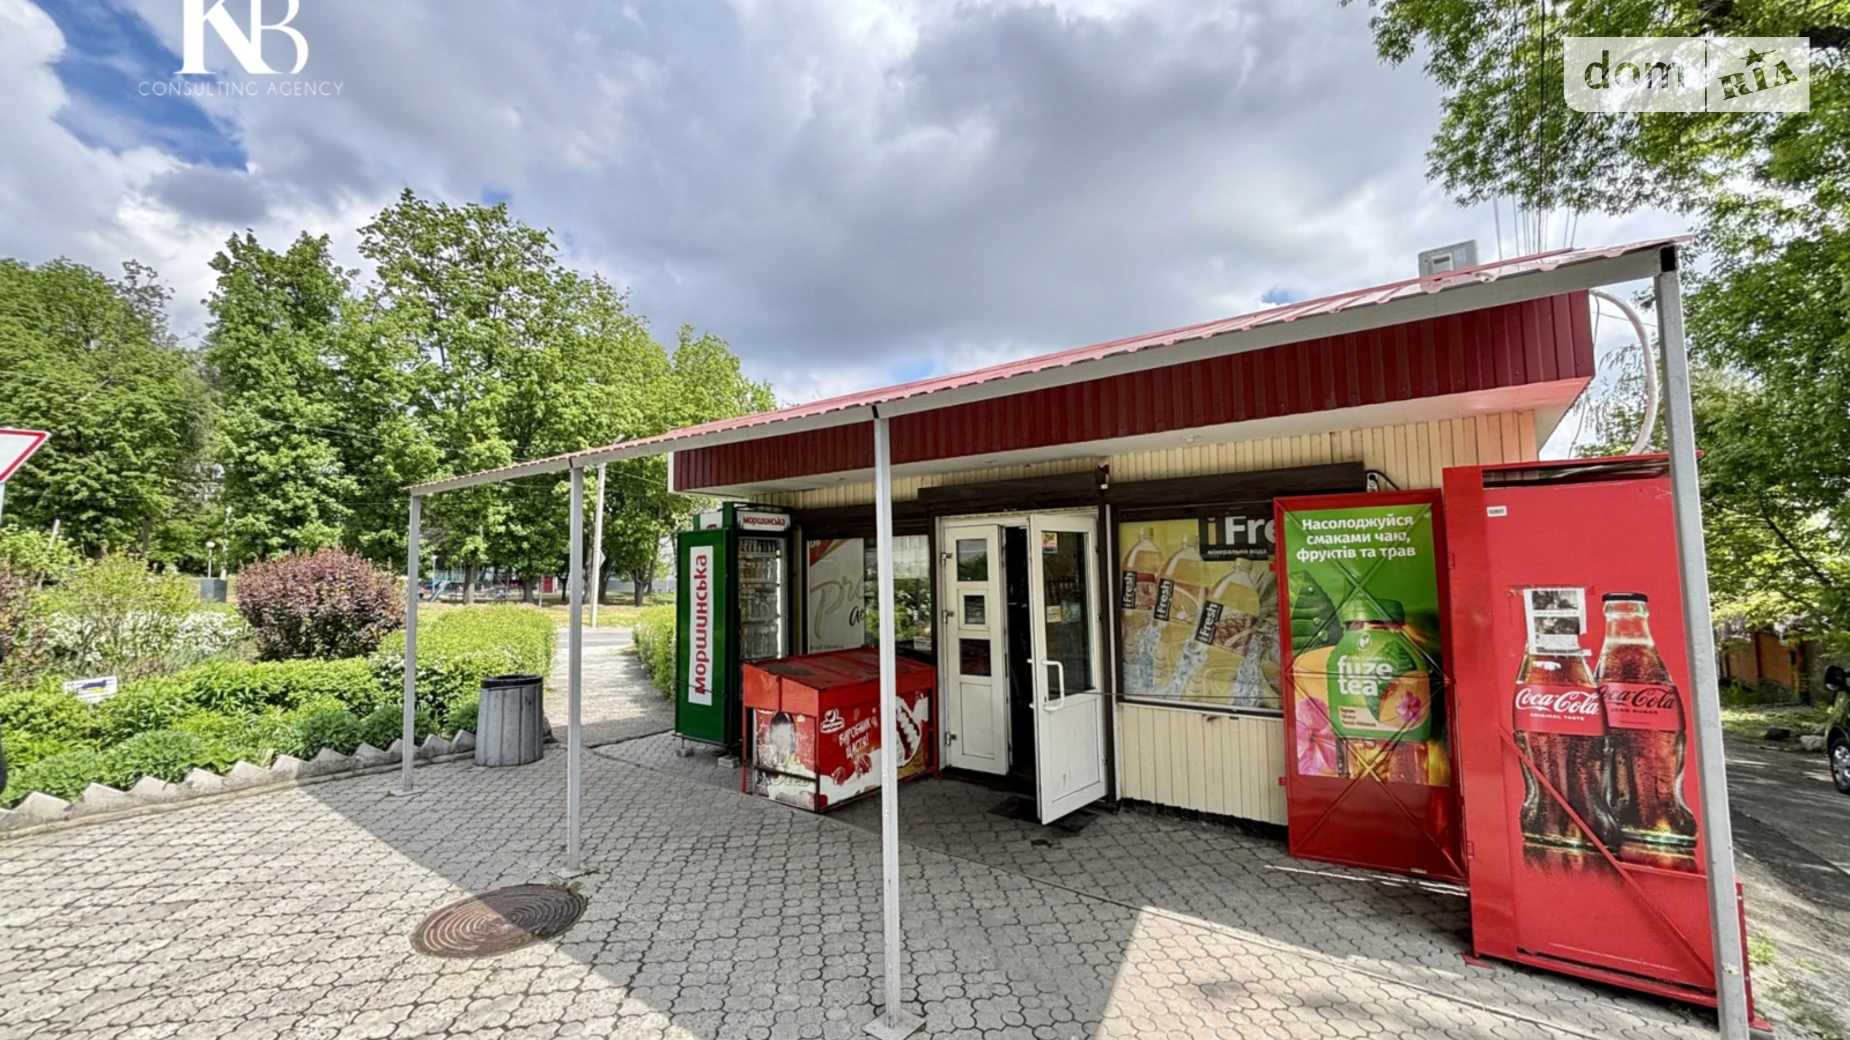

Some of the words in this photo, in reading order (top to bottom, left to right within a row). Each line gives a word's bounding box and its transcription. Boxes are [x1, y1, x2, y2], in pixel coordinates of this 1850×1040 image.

[743, 516, 786, 526] моршинська
[1302, 513, 1413, 531] Насолоджуйся
[1306, 533, 1371, 545] смаками
[1374, 531, 1410, 543] чаю,
[1296, 546, 1356, 562] фруктів
[1359, 548, 1377, 558] та
[1379, 546, 1416, 560] трав
[694, 554, 709, 695] моршинська
[1337, 655, 1393, 680] fuze
[1338, 673, 1378, 696] tea
[1515, 687, 1600, 716] Coca-Cola
[1529, 712, 1562, 720] ORIGINAL
[1564, 714, 1585, 722] TASTE
